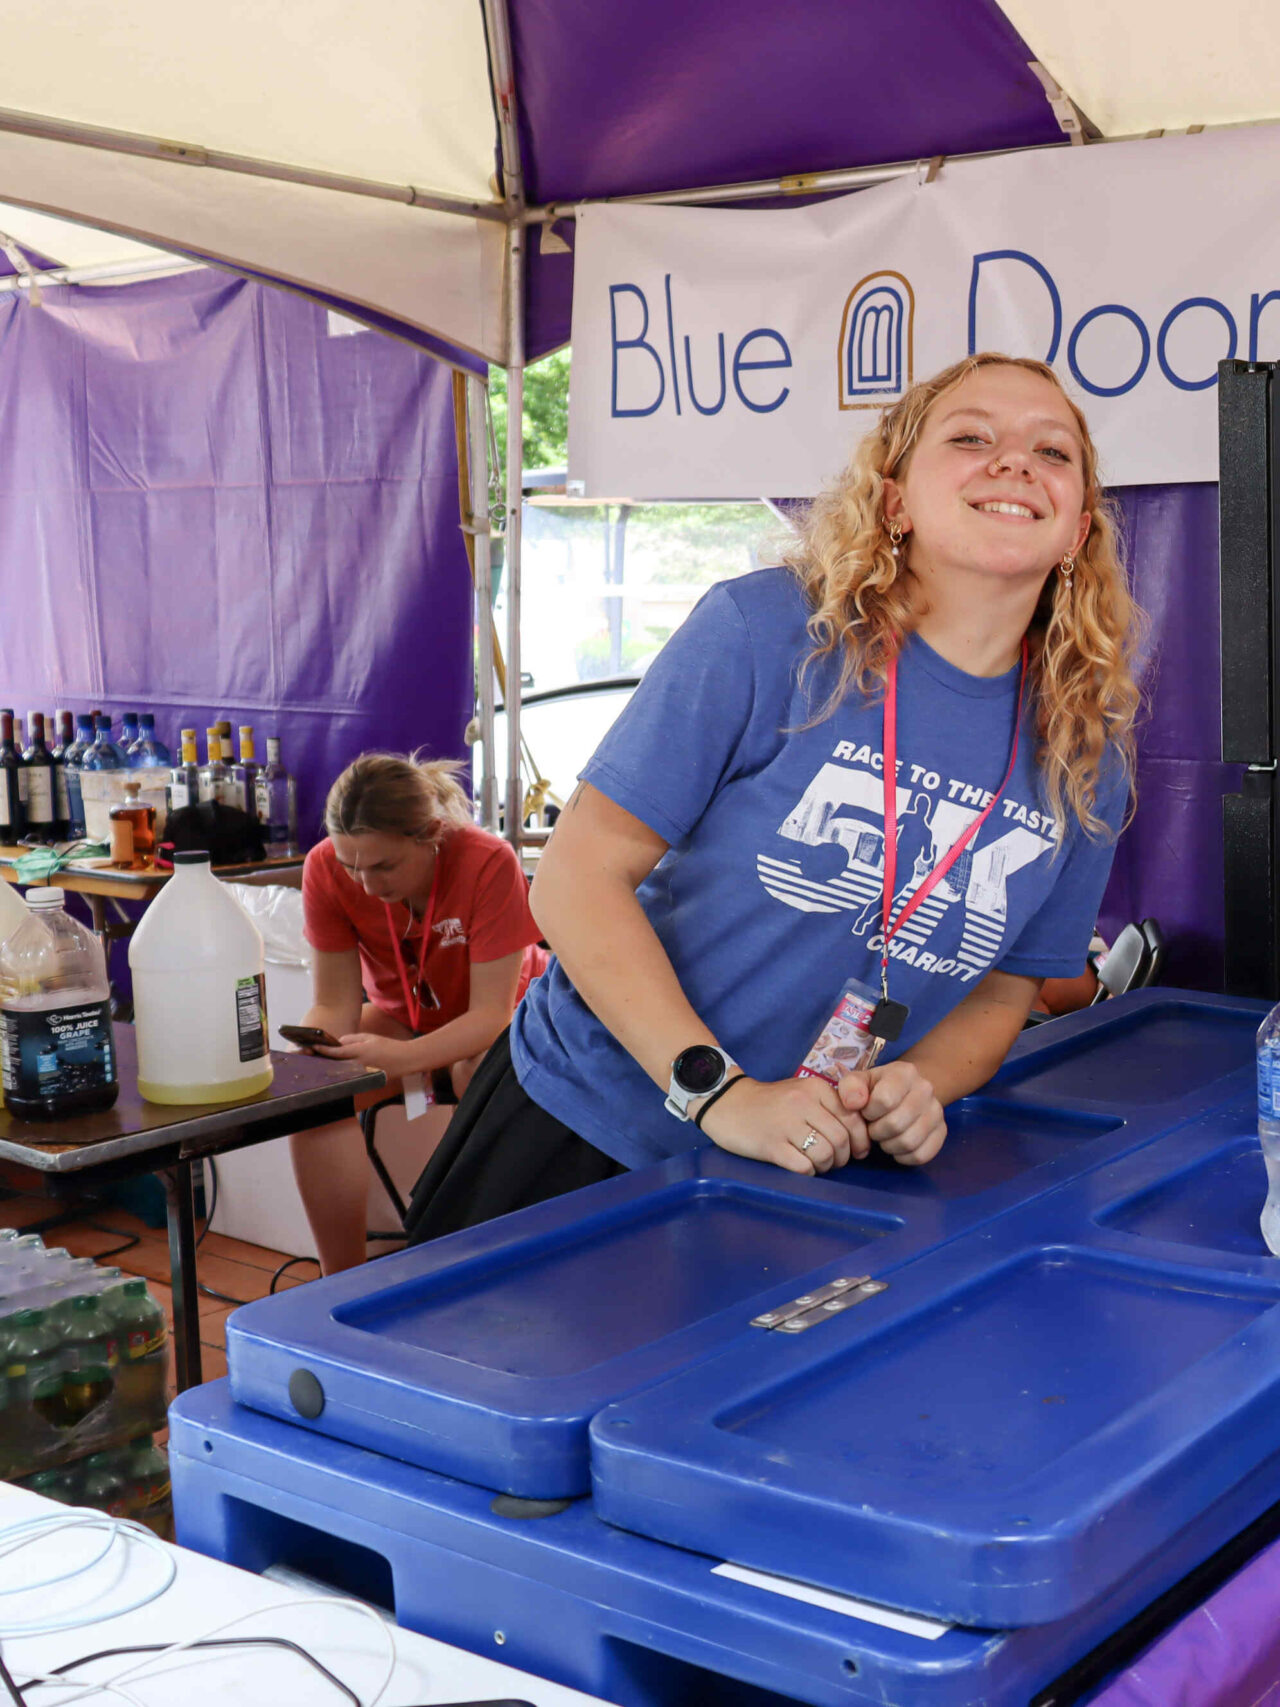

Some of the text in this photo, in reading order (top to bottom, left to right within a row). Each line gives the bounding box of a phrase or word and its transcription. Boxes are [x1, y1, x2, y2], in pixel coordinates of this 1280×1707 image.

[609, 273, 793, 418] Blue
[910, 763, 941, 790] TO
[947, 778, 997, 809] THE
[50, 1019, 99, 1034] 100% JUICE
[59, 1029, 91, 1040] GRAPE
